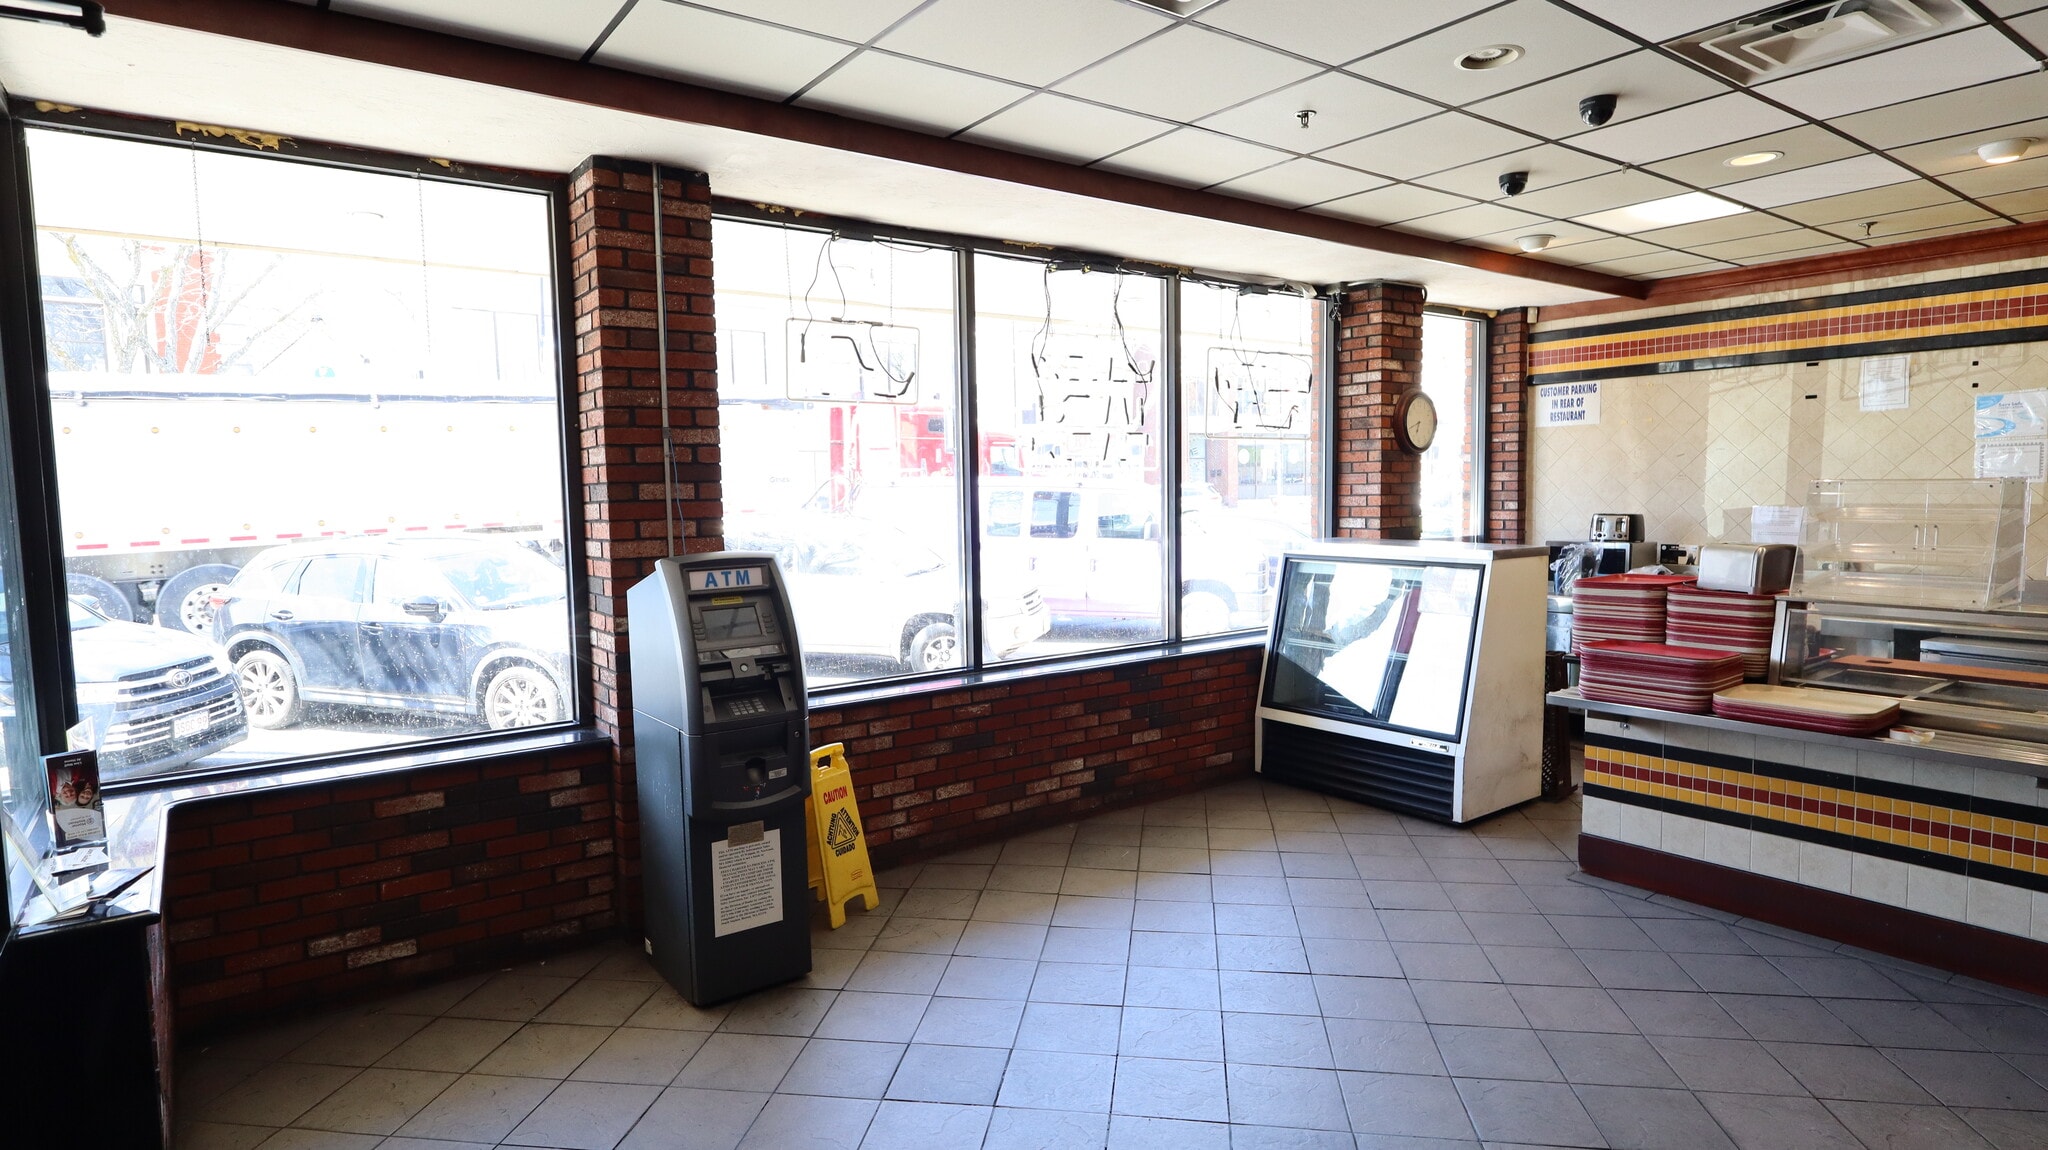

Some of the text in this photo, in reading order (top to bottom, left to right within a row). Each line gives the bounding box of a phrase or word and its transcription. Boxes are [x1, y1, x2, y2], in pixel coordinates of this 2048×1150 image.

[1540, 383, 1597, 398] CUSTOMER PARKING
[1552, 397, 1584, 409] IN REAR OF
[1550, 410, 1586, 422] RESTAURANT
[705, 570, 750, 588] ATM
[823, 785, 848, 805] CAUTION
[826, 812, 837, 846] ACHTUNG
[840, 807, 860, 837] ATTENTION
[835, 843, 856, 857] CUIDADO
